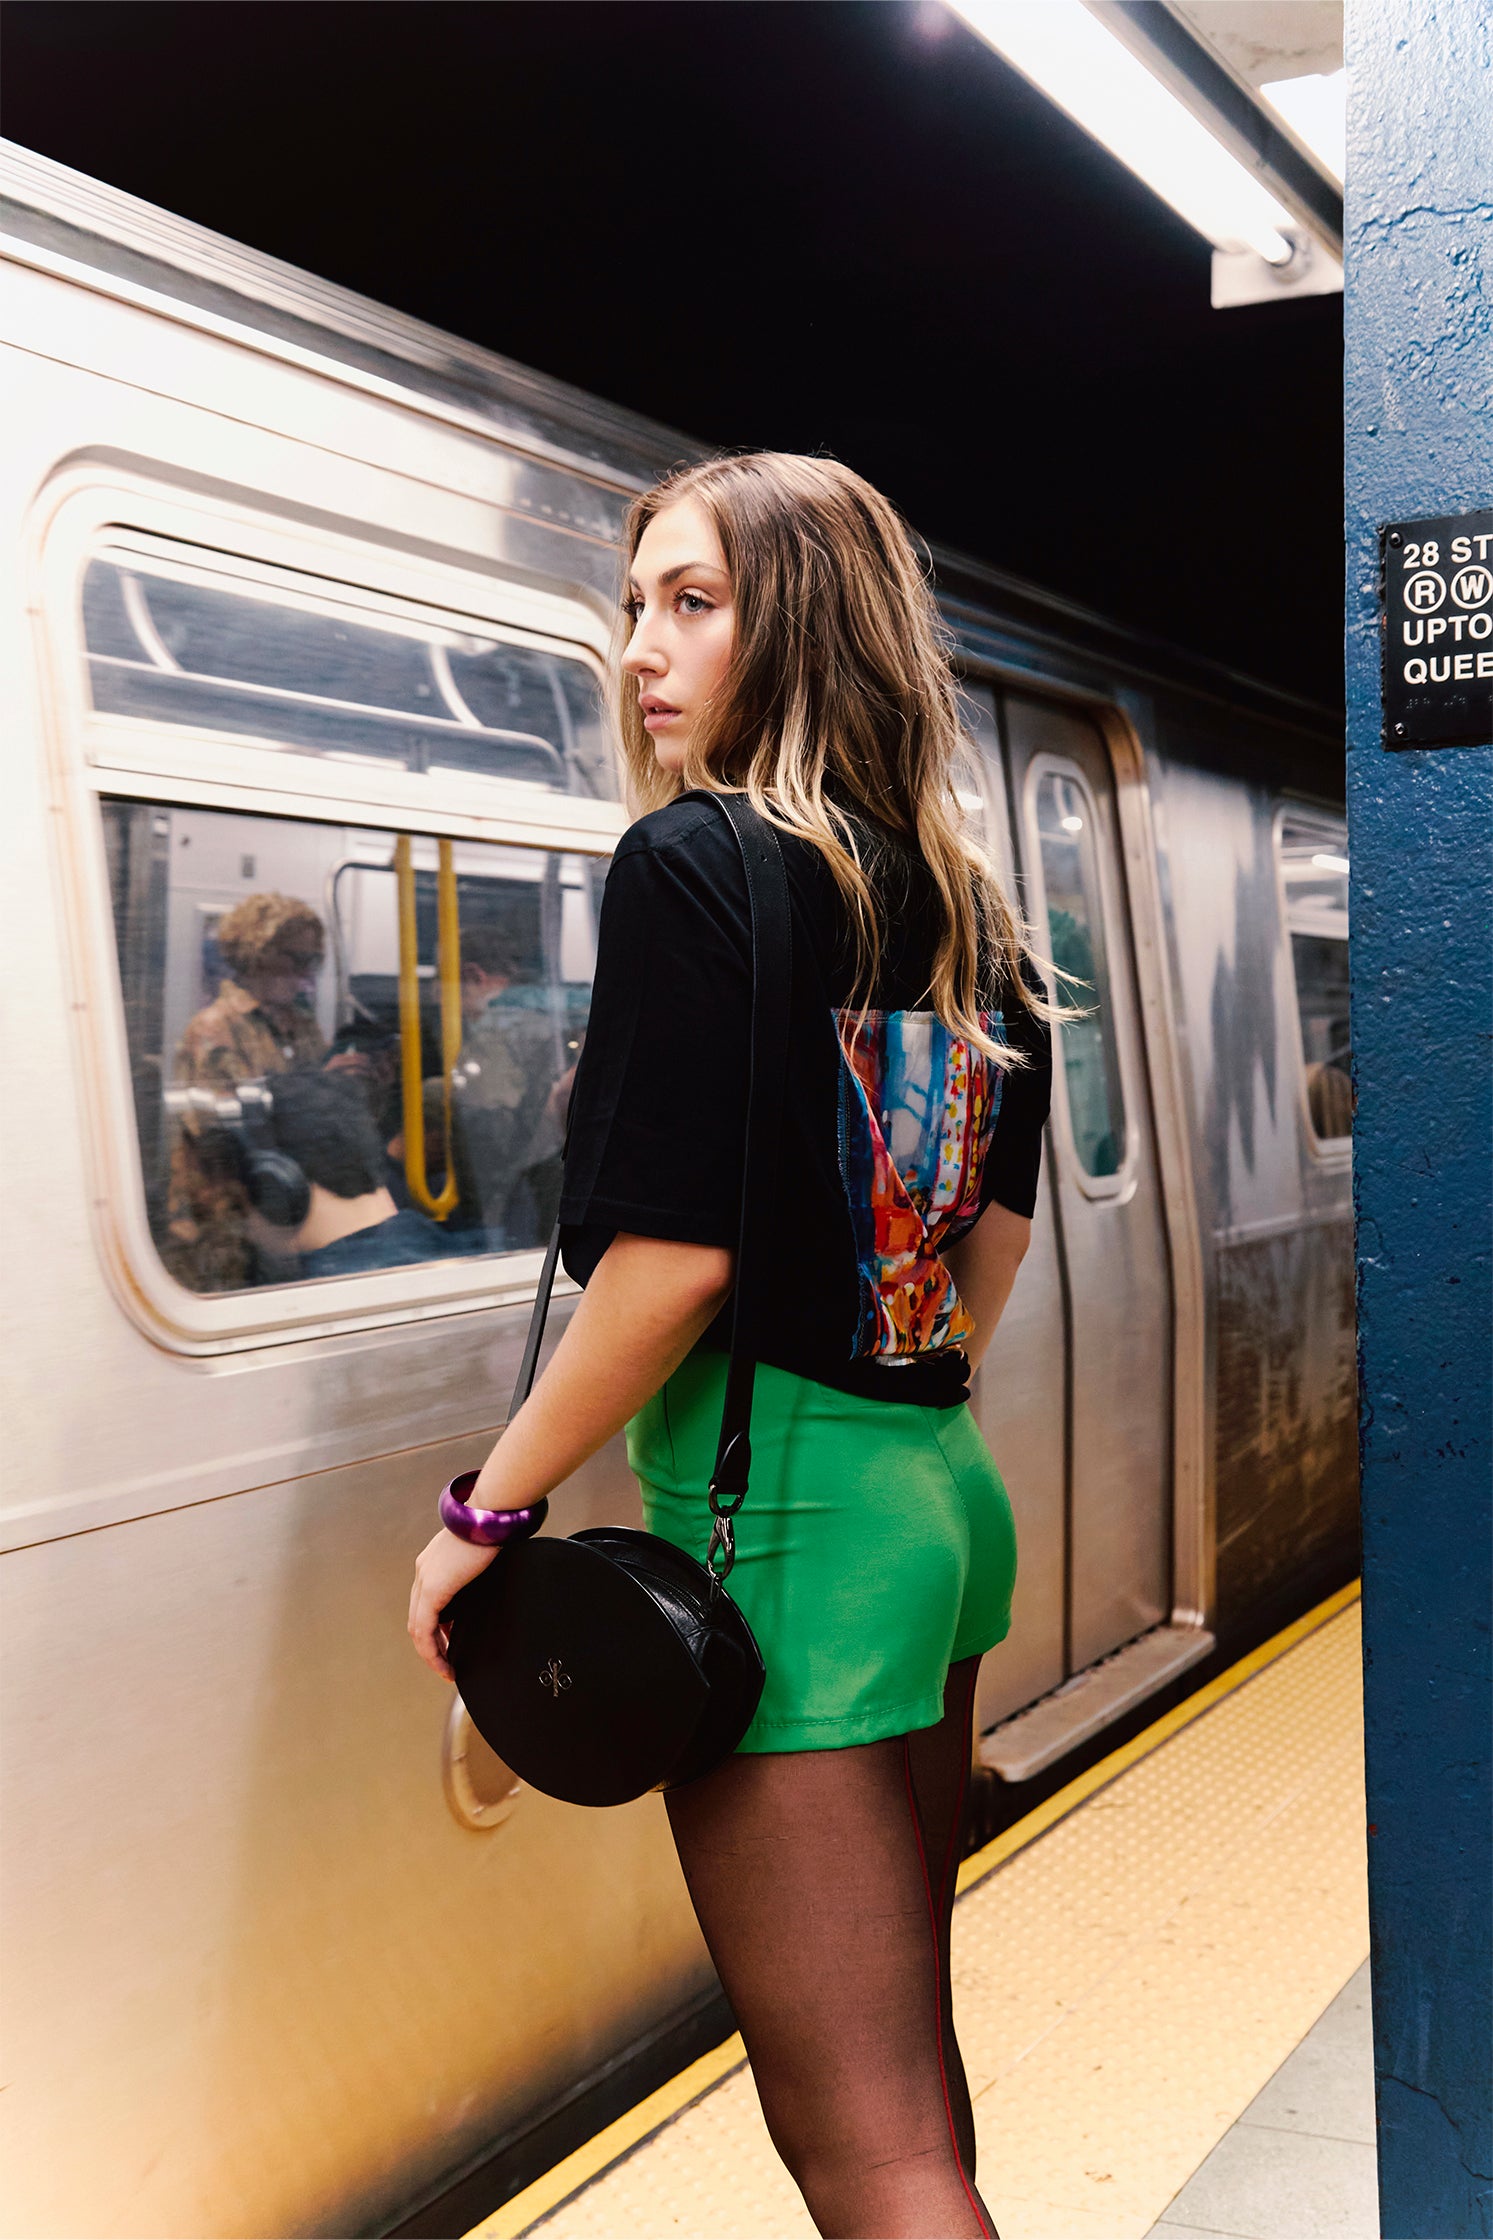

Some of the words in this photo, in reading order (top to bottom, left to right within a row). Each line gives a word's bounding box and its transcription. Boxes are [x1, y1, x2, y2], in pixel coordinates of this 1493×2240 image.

[1403, 541, 1440, 569] 28
[1451, 533, 1493, 564] ST
[1403, 613, 1493, 646] UPTO
